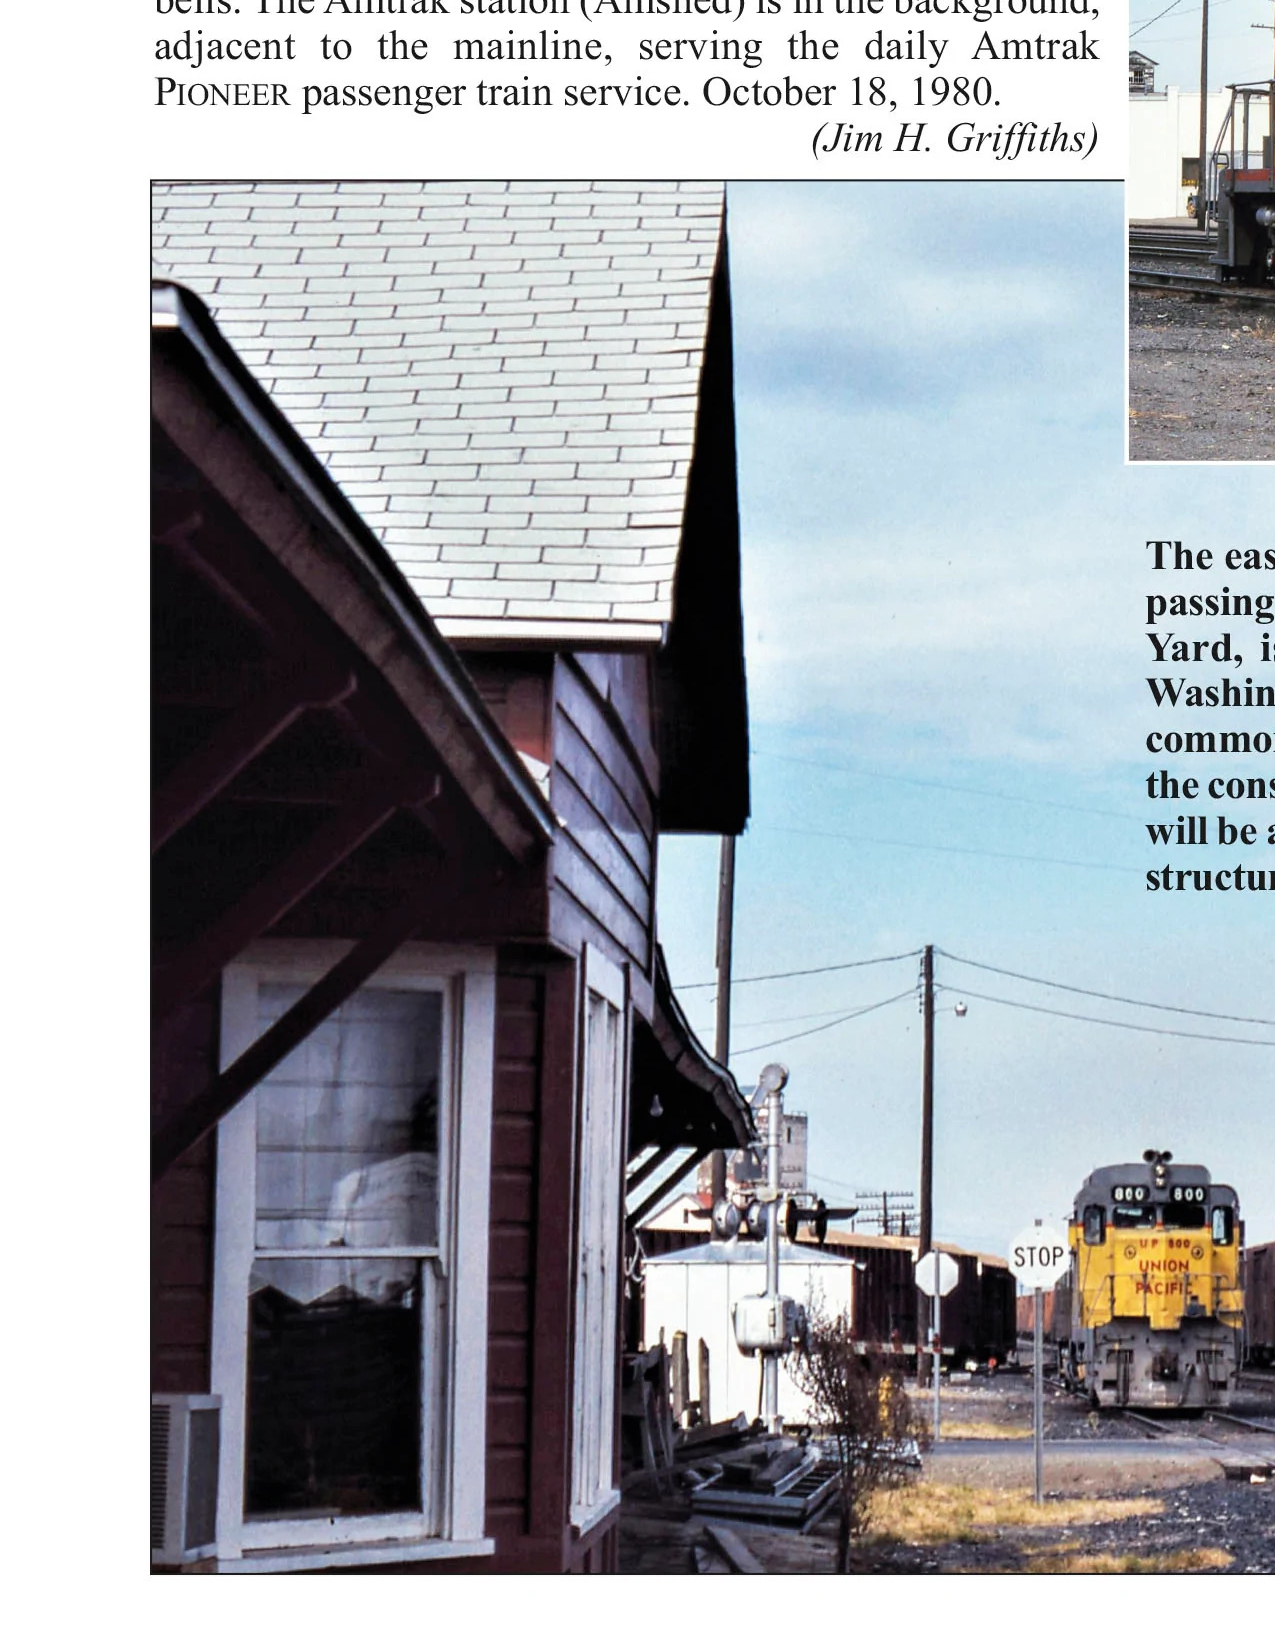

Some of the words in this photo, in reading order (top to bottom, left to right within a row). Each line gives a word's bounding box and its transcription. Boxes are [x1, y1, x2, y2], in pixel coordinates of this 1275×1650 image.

[1115, 1187, 1144, 1201] 800
[1174, 1187, 1204, 1201] 800
[1168, 1238, 1191, 1249] 800
[1014, 1246, 1064, 1268] STOP
[1139, 1260, 1189, 1272] UNION
